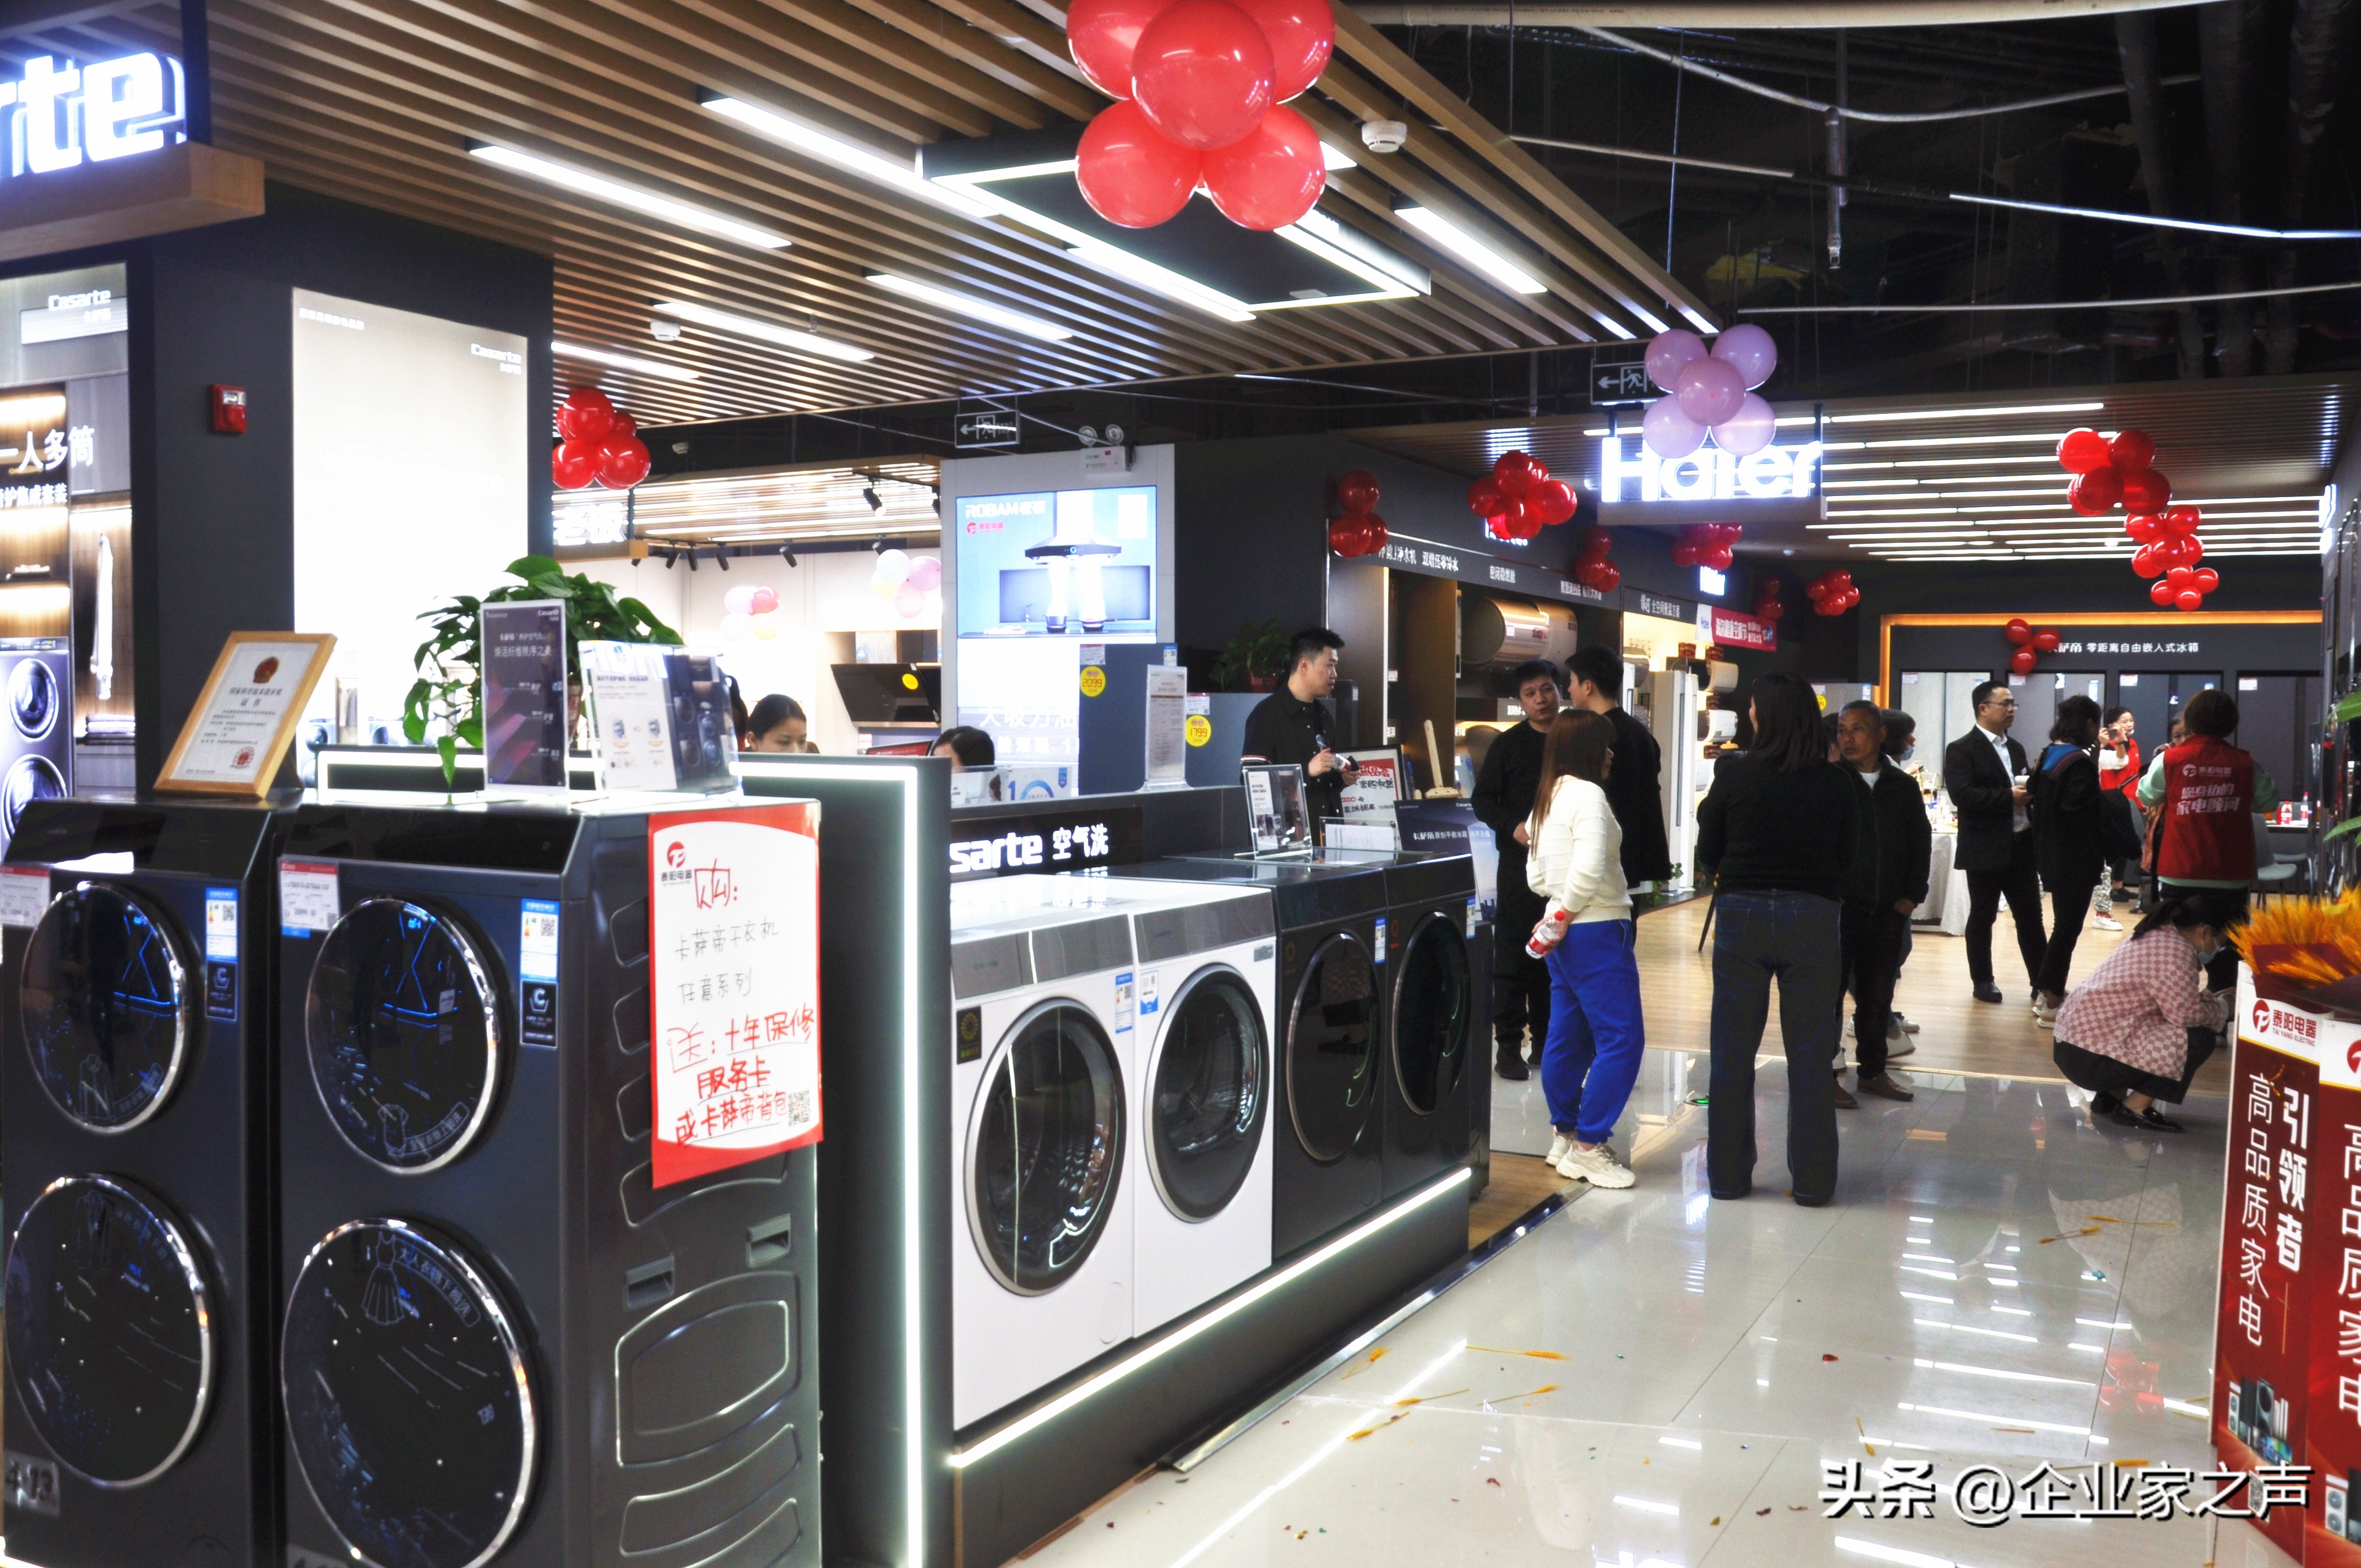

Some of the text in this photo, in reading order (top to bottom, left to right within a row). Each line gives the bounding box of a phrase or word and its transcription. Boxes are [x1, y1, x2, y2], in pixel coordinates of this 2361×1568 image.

[48, 290, 111, 312] Casarte
[470, 342, 522, 364] Casarte
[1601, 436, 1821, 503] Haier
[2086, 642, 2199, 654] 零距离自由嵌入式冰箱
[1082, 678, 1103, 688] 2099
[1190, 727, 1208, 737] 1799
[2176, 796, 2241, 815] 家电顾问
[2180, 783, 2235, 799] 您身边的
[949, 823, 1109, 874] sarte 空气洗
[674, 915, 778, 962] 卡萨帝干衣机
[678, 966, 753, 1005] 任意系列
[2272, 1009, 2317, 1039] 泰阳电器
[697, 1054, 771, 1099] 服务卡
[2276, 1086, 2310, 1273] 引领者
[2238, 1072, 2273, 1347] 高品质家电
